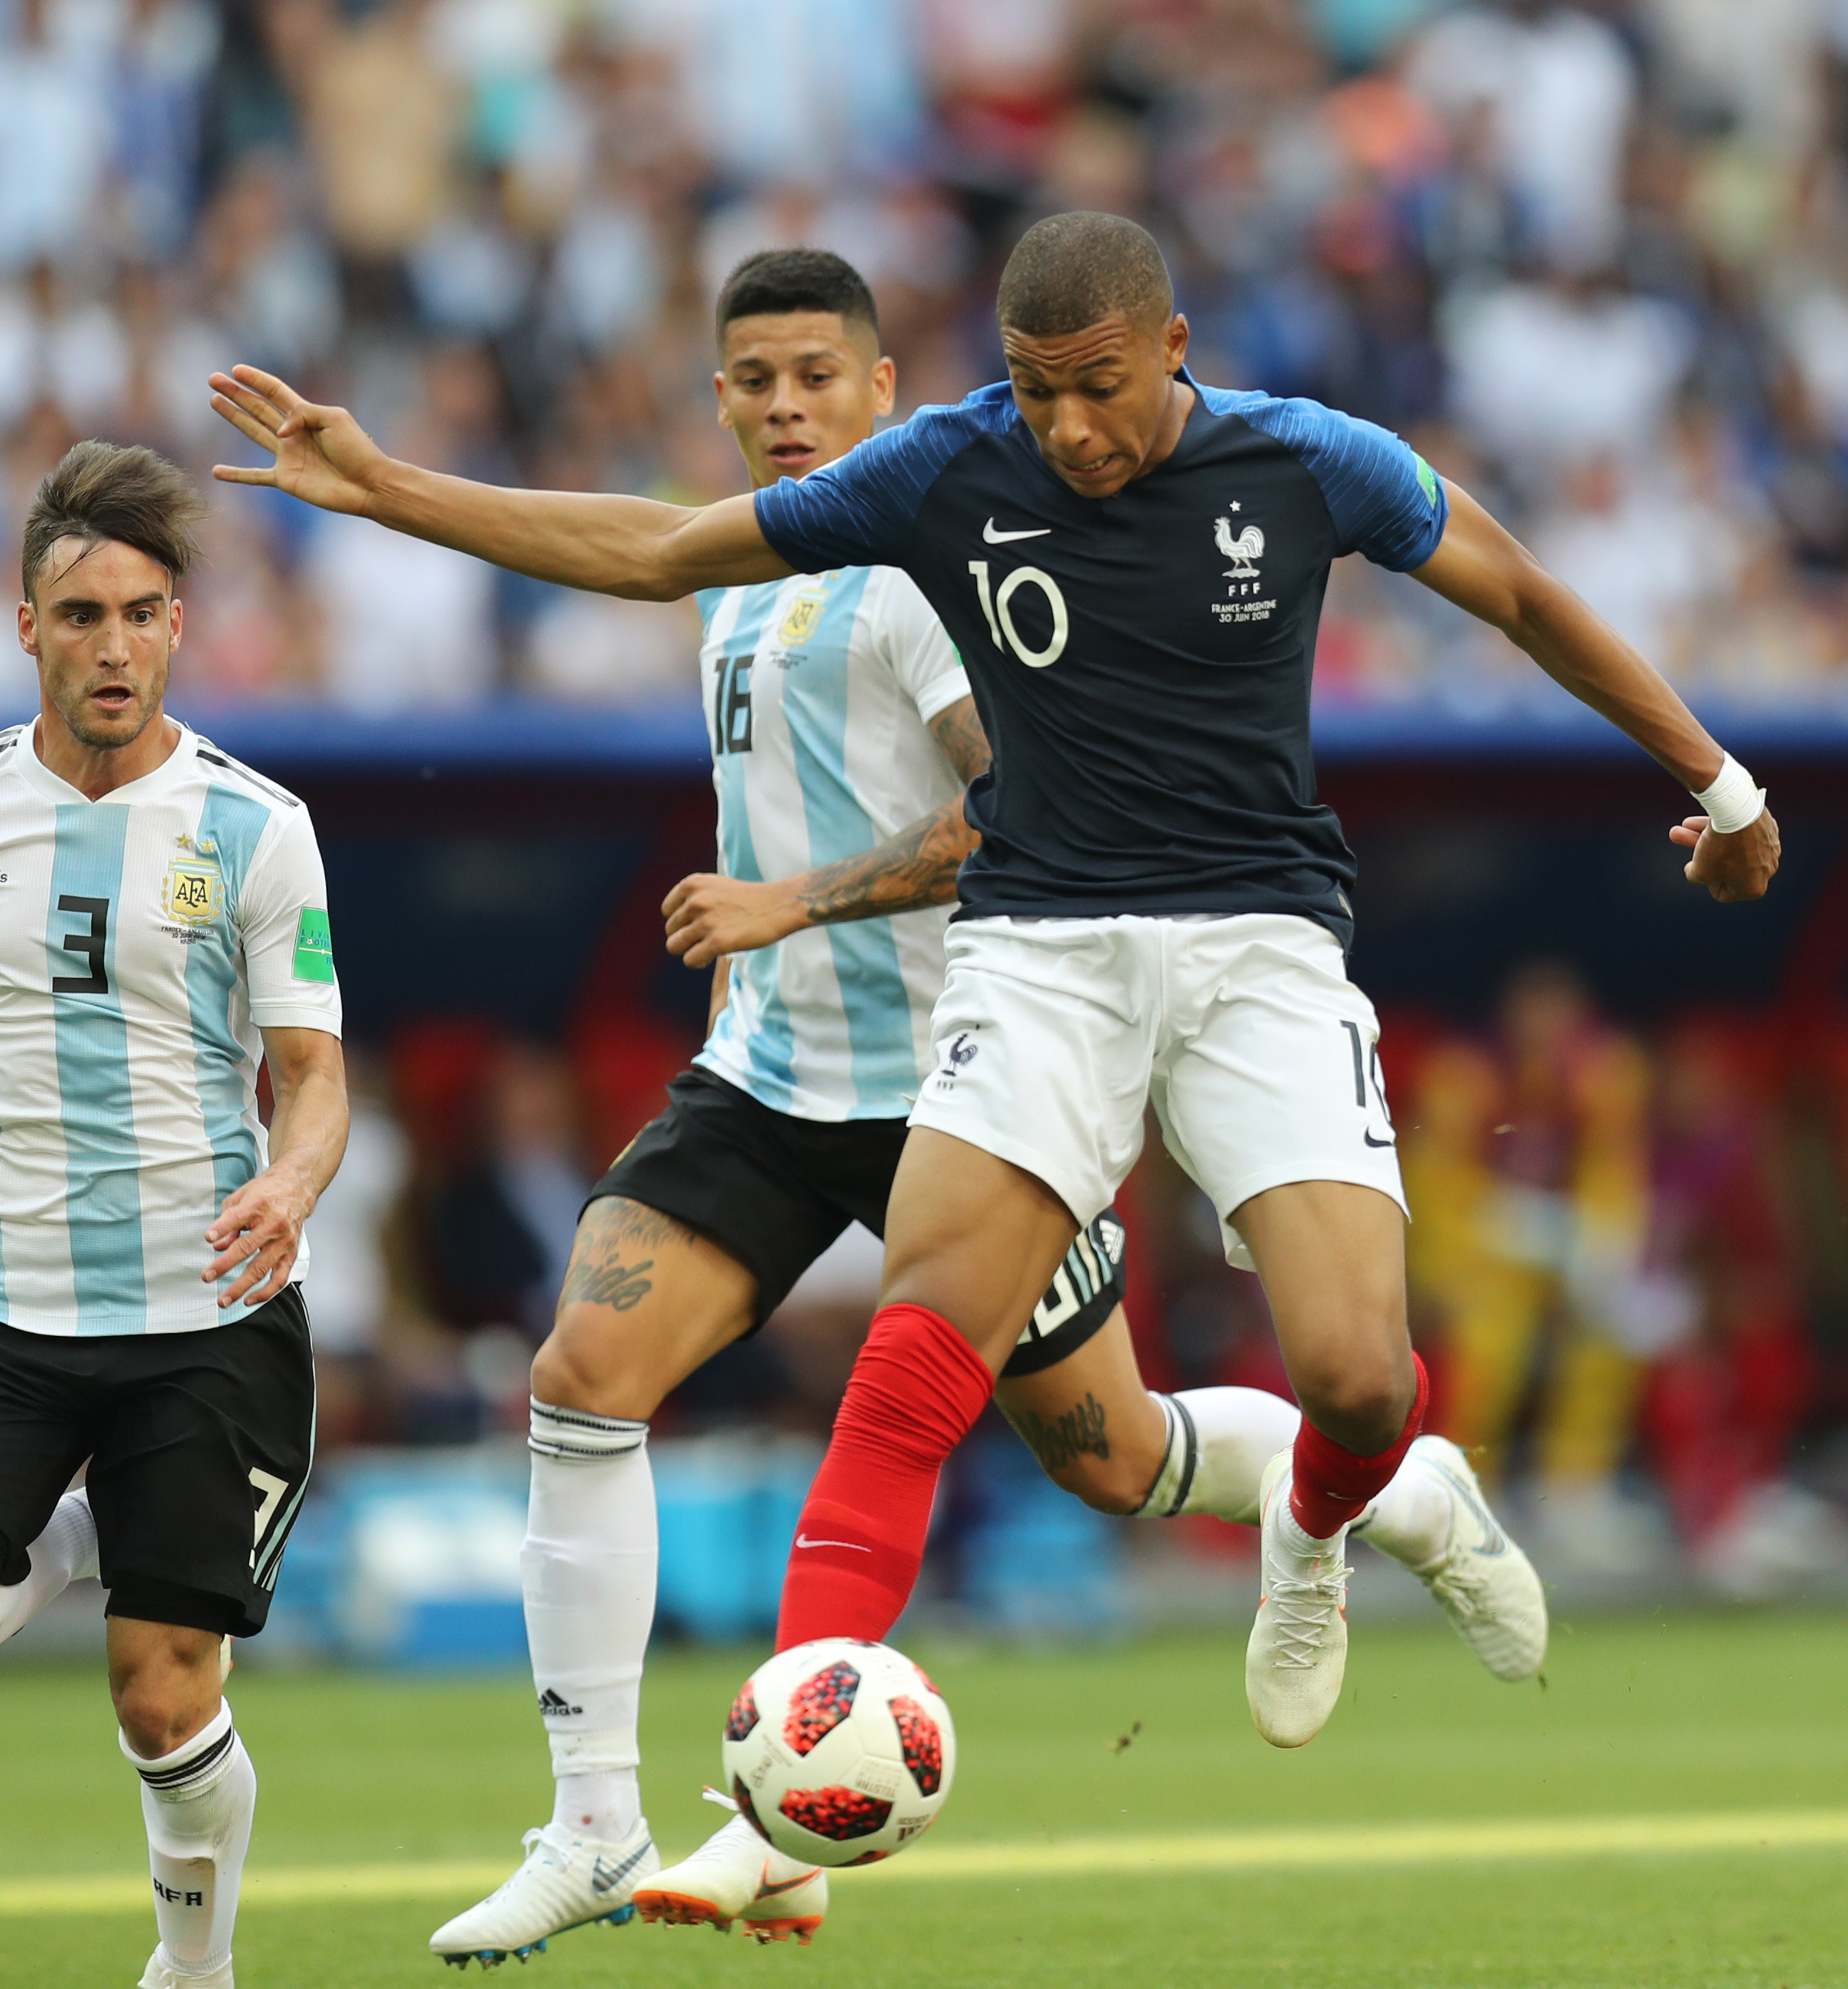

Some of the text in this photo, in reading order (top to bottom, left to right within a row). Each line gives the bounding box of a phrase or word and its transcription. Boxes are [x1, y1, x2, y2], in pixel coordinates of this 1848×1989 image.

[968, 560, 1068, 667] 10
[1218, 610, 1270, 623] 30 JUIN 2018
[714, 654, 756, 755] 16
[175, 874, 207, 908] AFA
[52, 895, 110, 994] 3
[153, 1877, 203, 1906] AFA
